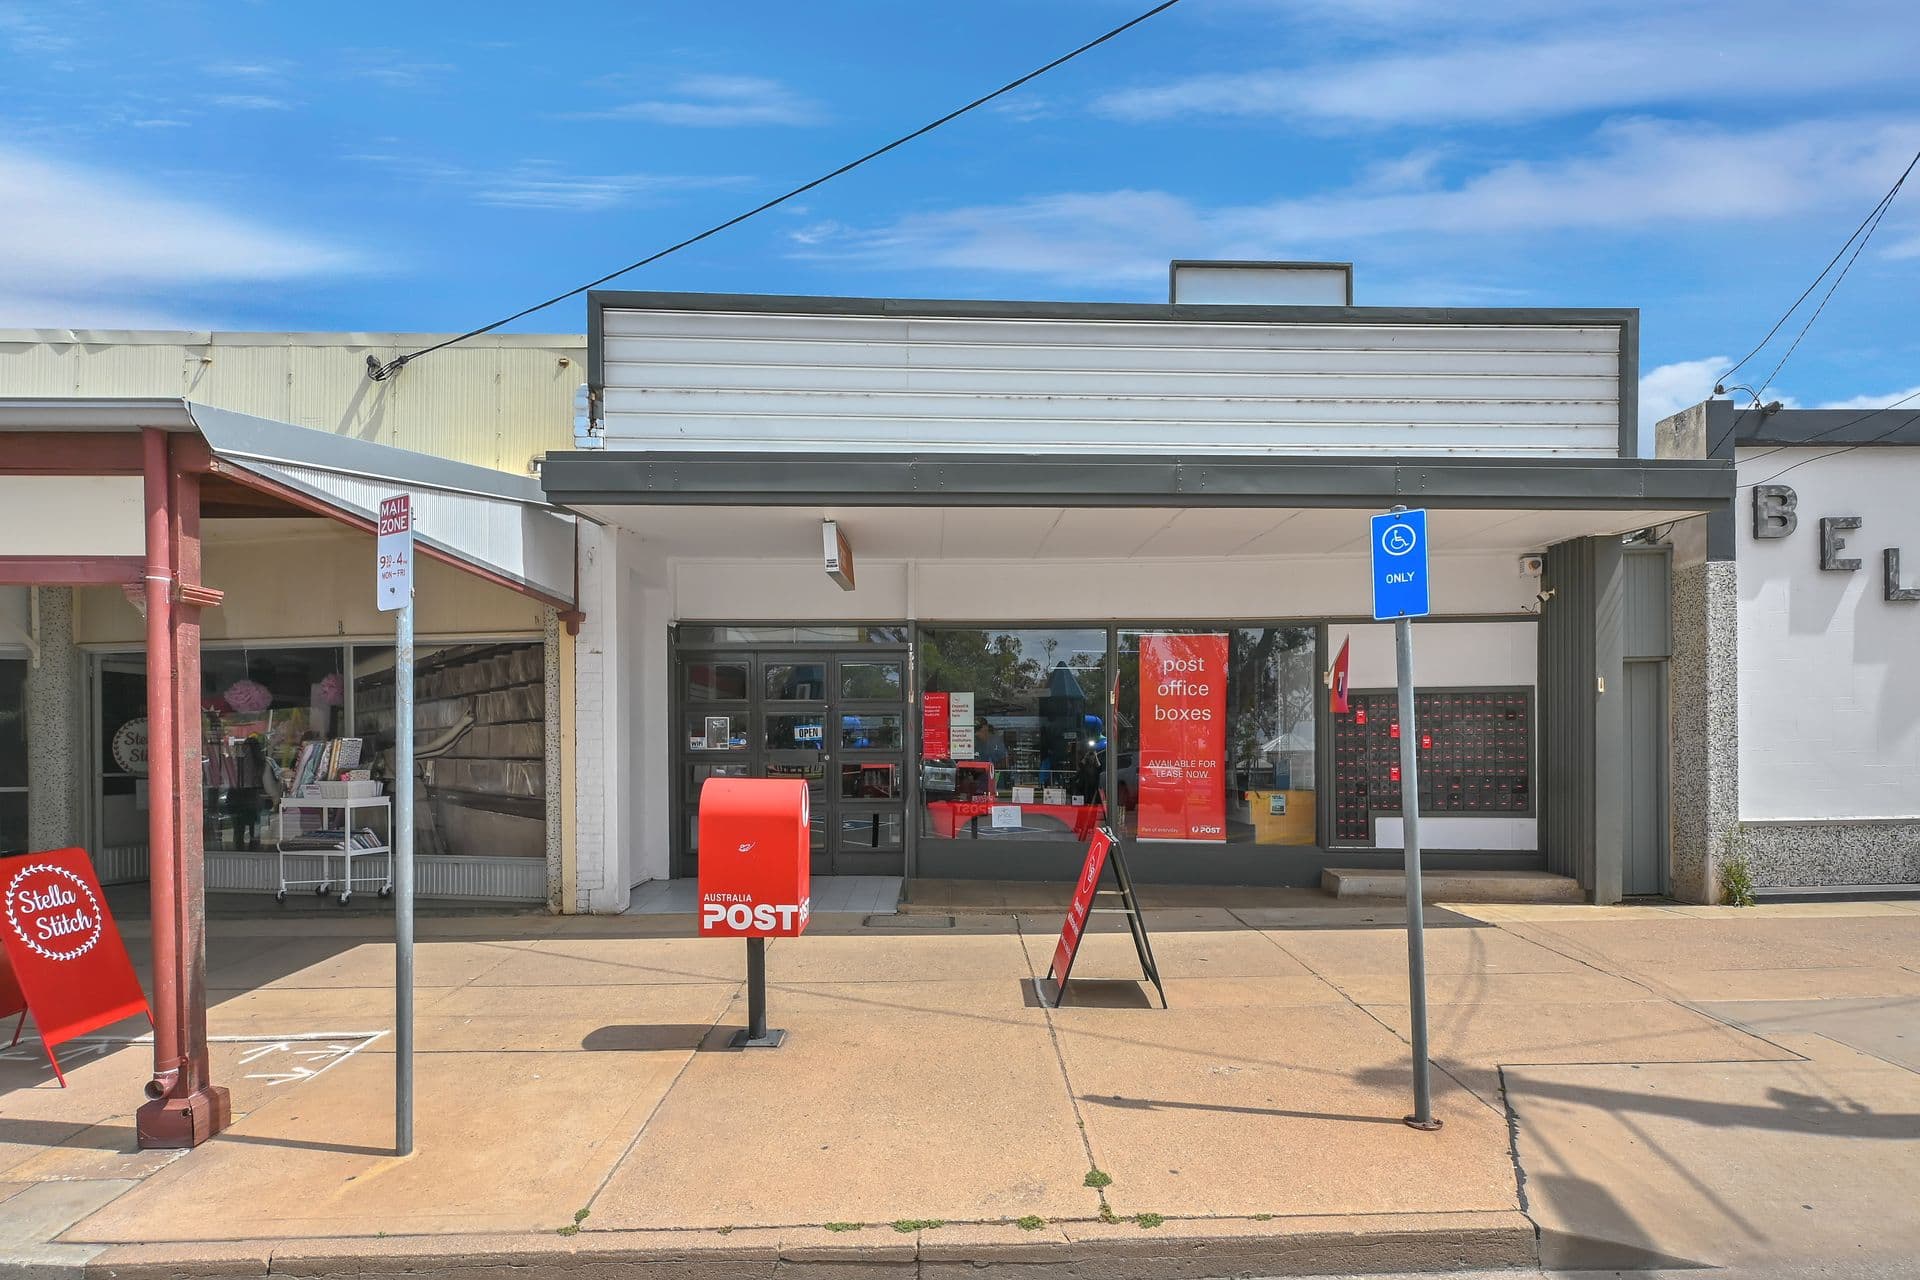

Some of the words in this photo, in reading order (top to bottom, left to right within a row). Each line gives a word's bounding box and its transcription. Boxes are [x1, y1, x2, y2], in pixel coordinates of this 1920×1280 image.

[381, 498, 408, 517] MAIL
[381, 515, 407, 534] ZONE
[1385, 571, 1416, 585] ONLY
[1163, 657, 1205, 676] post
[1157, 679, 1209, 697] office
[1155, 704, 1212, 721] boxes
[799, 728, 819, 738] OPEN
[1149, 759, 1196, 768] AVAILABLE
[1198, 760, 1216, 768] FOR
[1156, 769, 1184, 778] LEASE
[1186, 770, 1209, 778] NOW
[18, 884, 76, 913] Stella
[703, 893, 752, 902] AUSTRALIA
[36, 908, 92, 940] Stitch
[703, 903, 798, 931] POST
